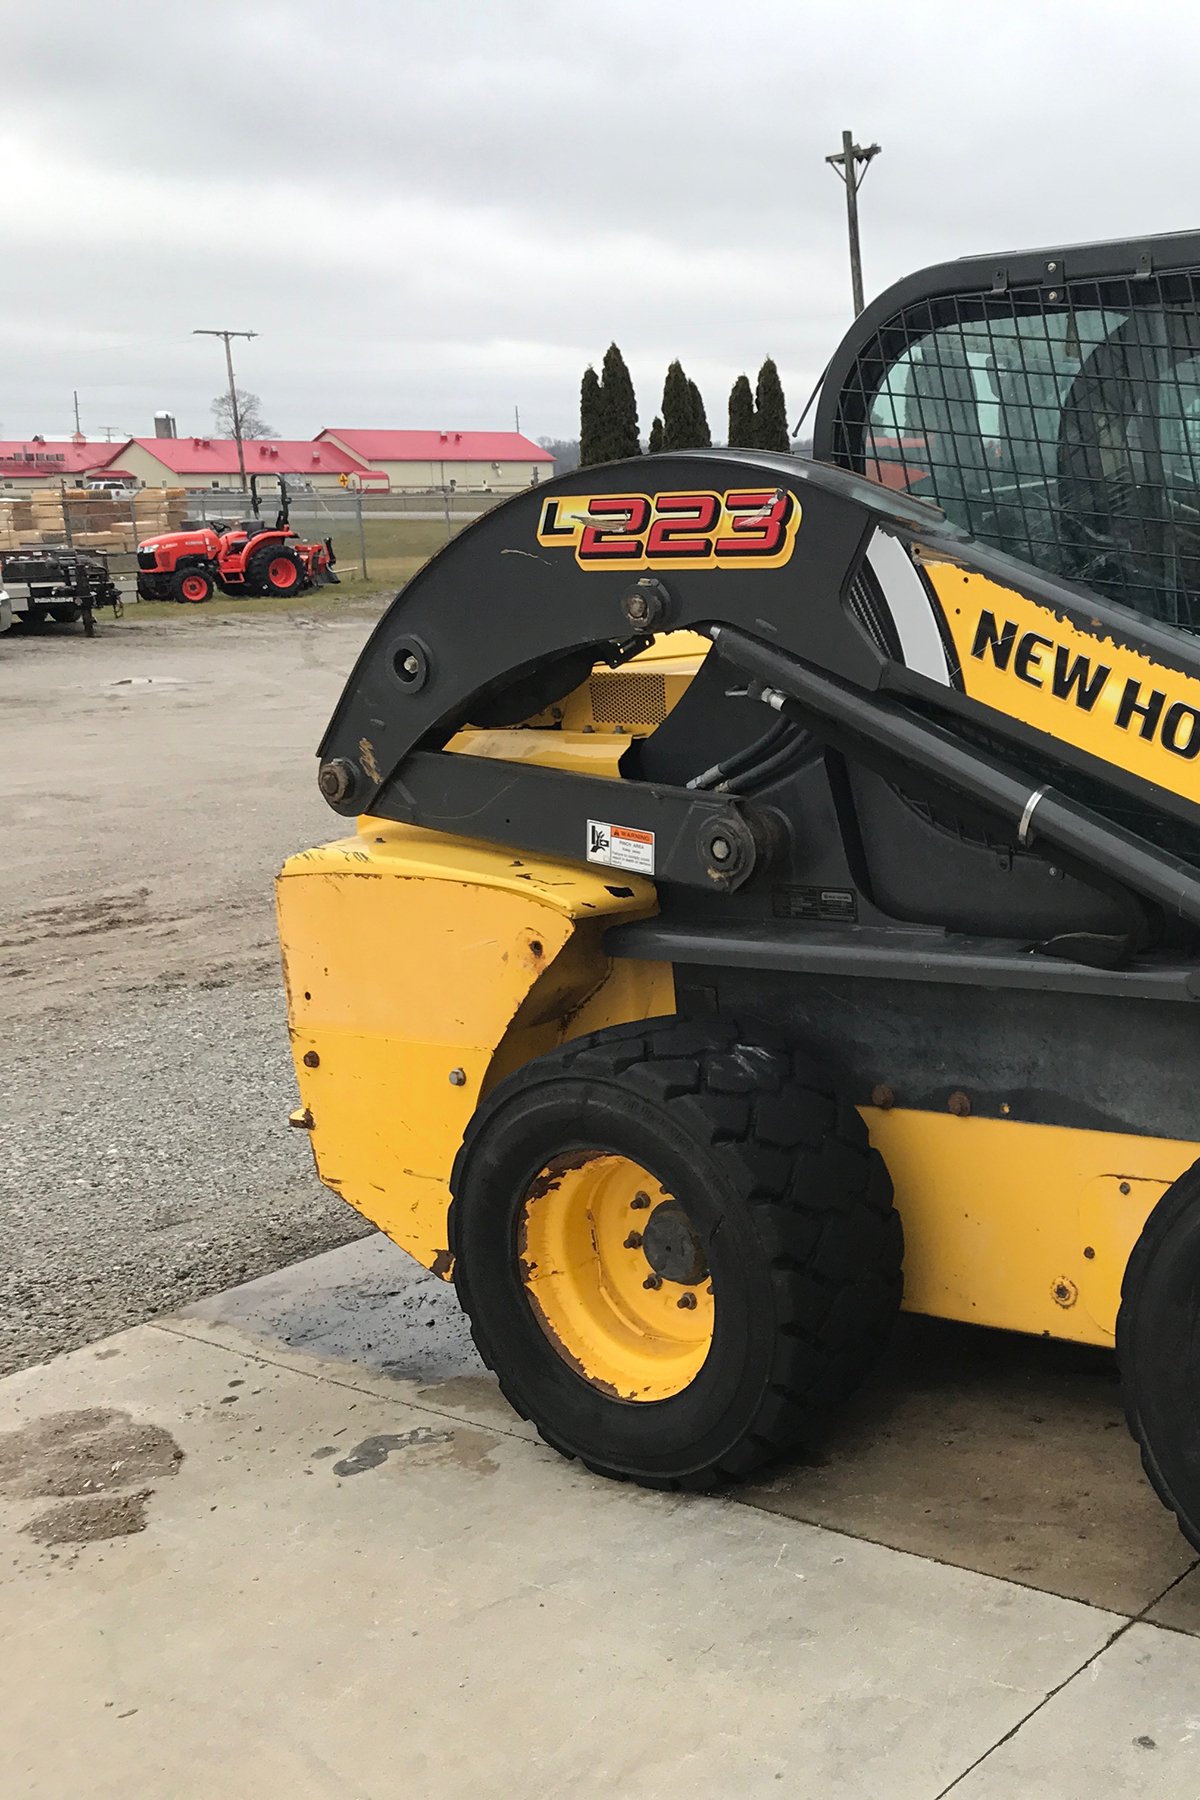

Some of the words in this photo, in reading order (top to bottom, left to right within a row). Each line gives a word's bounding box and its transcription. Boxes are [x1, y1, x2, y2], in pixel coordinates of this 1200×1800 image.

[540, 493, 791, 559] L223
[971, 608, 1111, 712] NEW
[620, 830, 651, 841] WARNING
